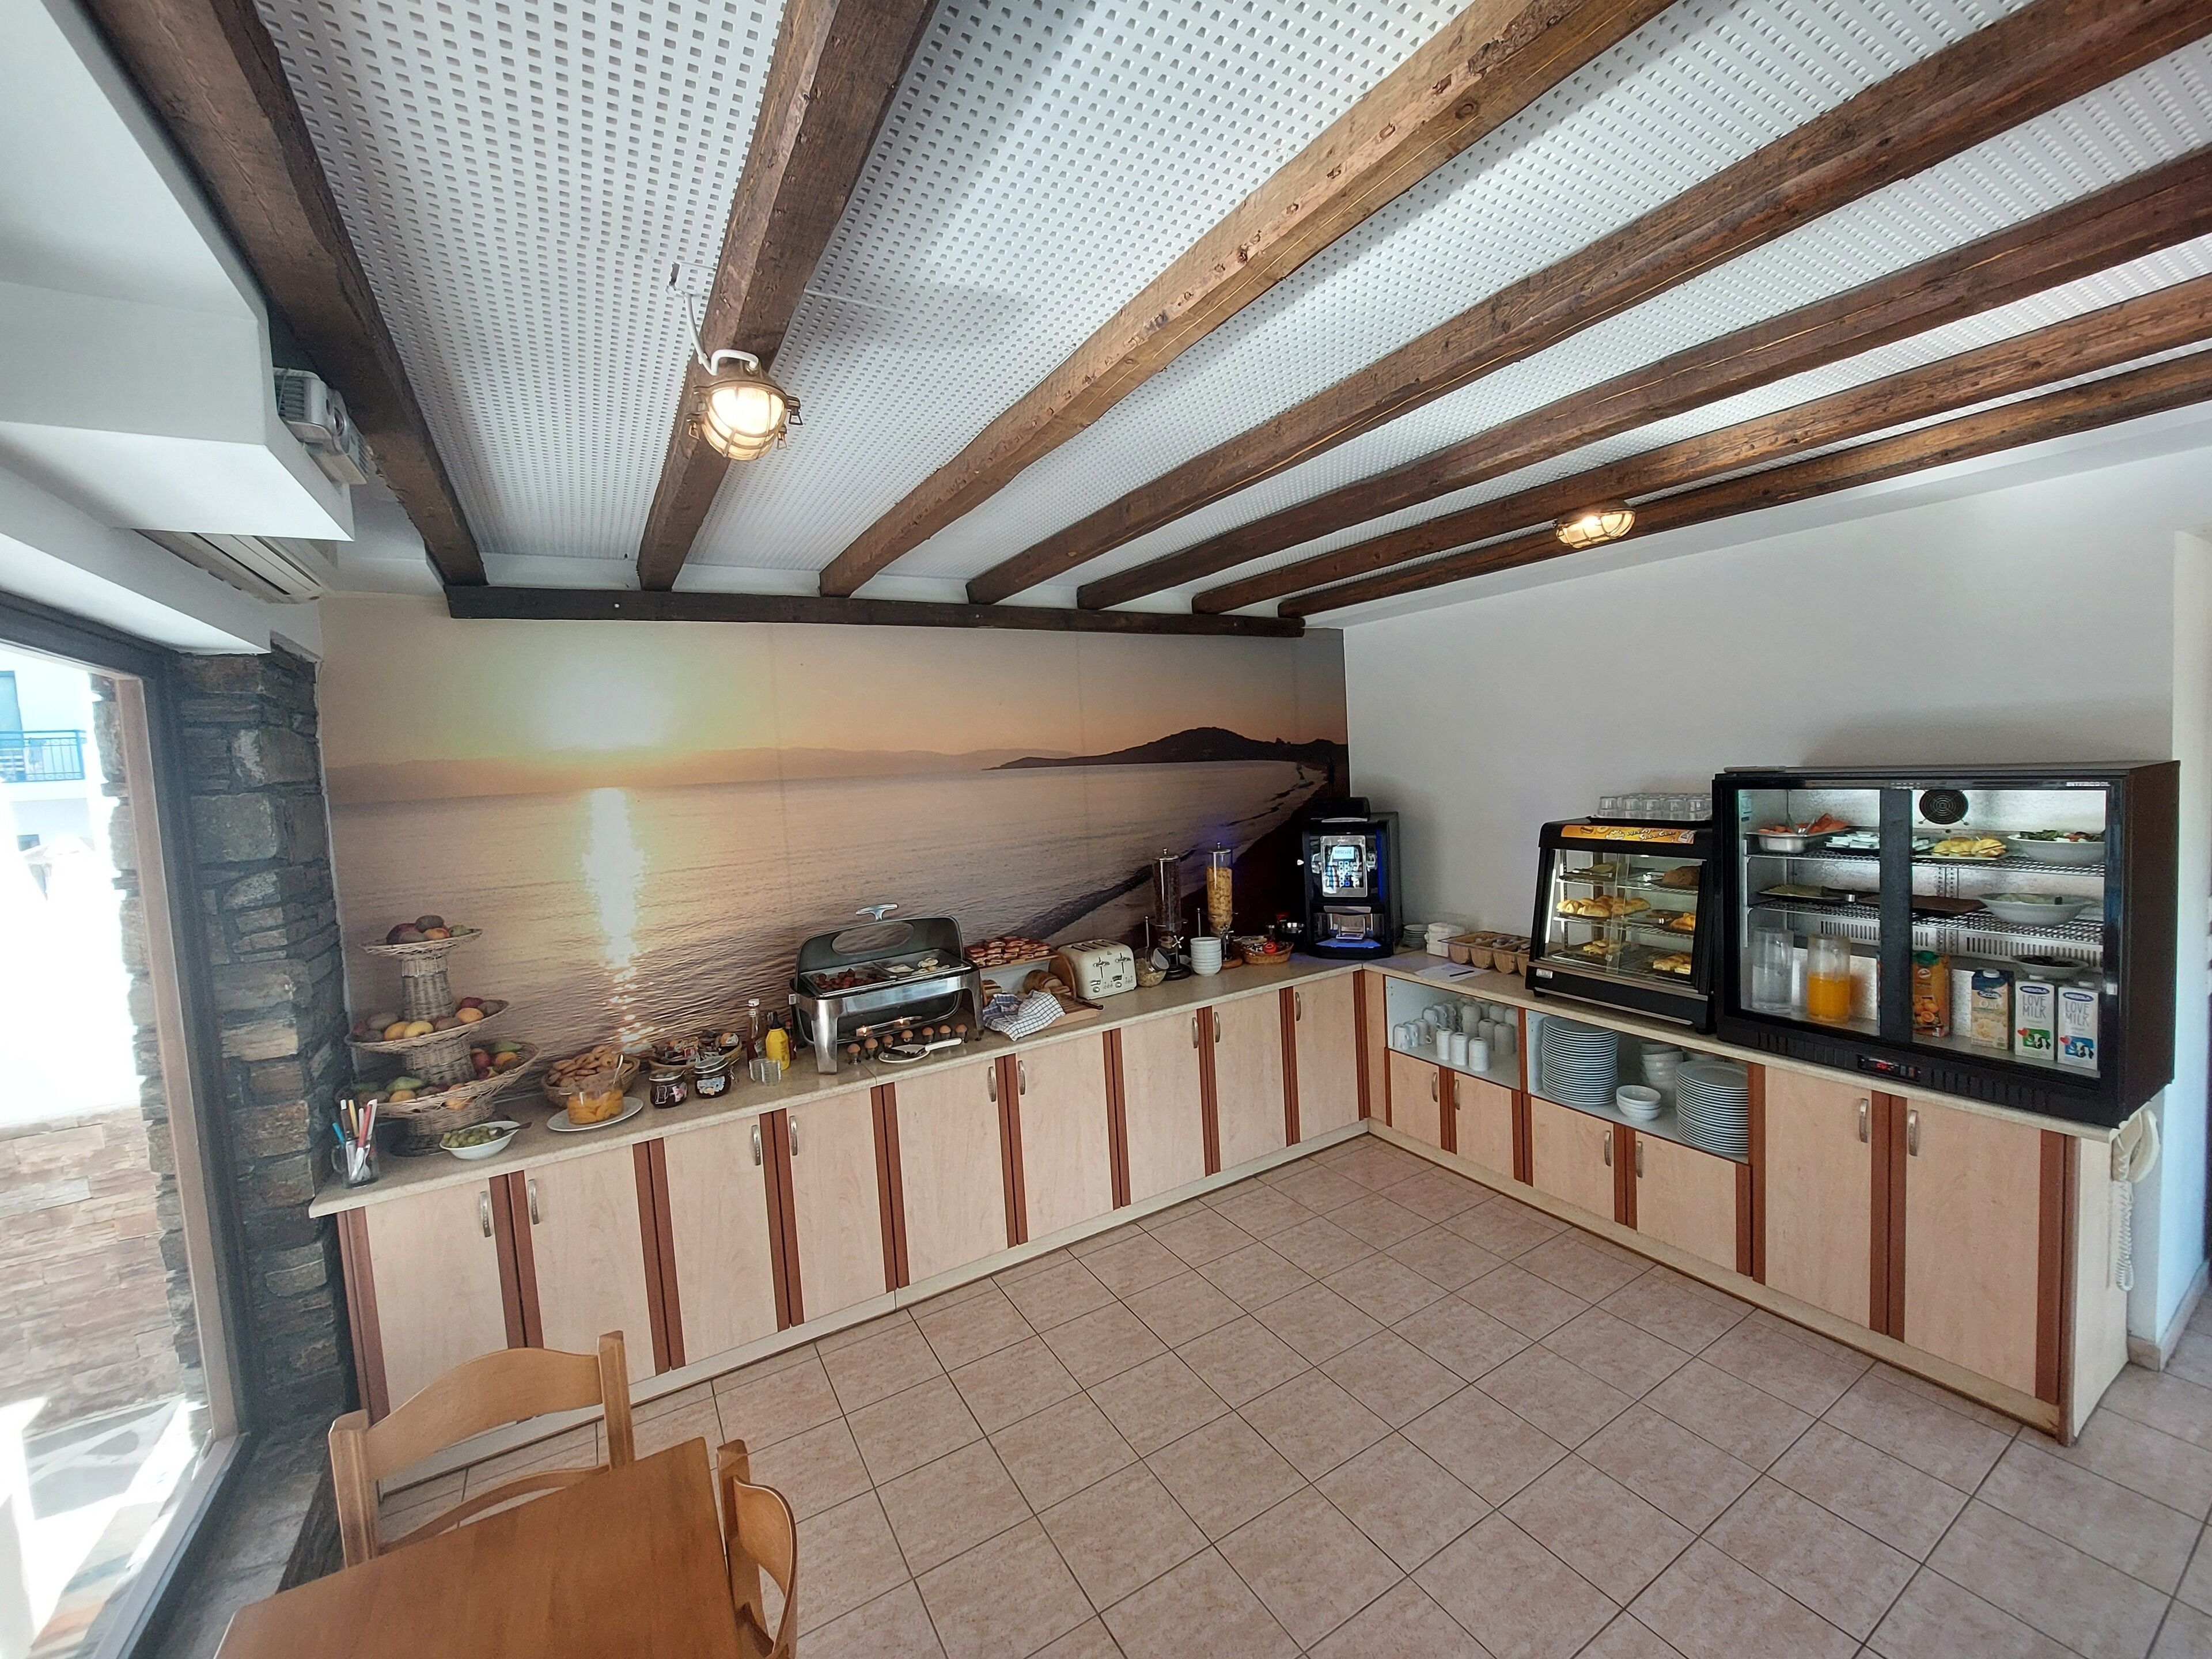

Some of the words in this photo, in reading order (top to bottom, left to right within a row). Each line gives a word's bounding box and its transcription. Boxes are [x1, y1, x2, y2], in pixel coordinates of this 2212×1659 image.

[2022, 994, 2046, 1007] LOVE
[2022, 1005, 2046, 1018] MILK
[2065, 1001, 2089, 1015] LOVE
[2065, 1012, 2089, 1027] MILK
